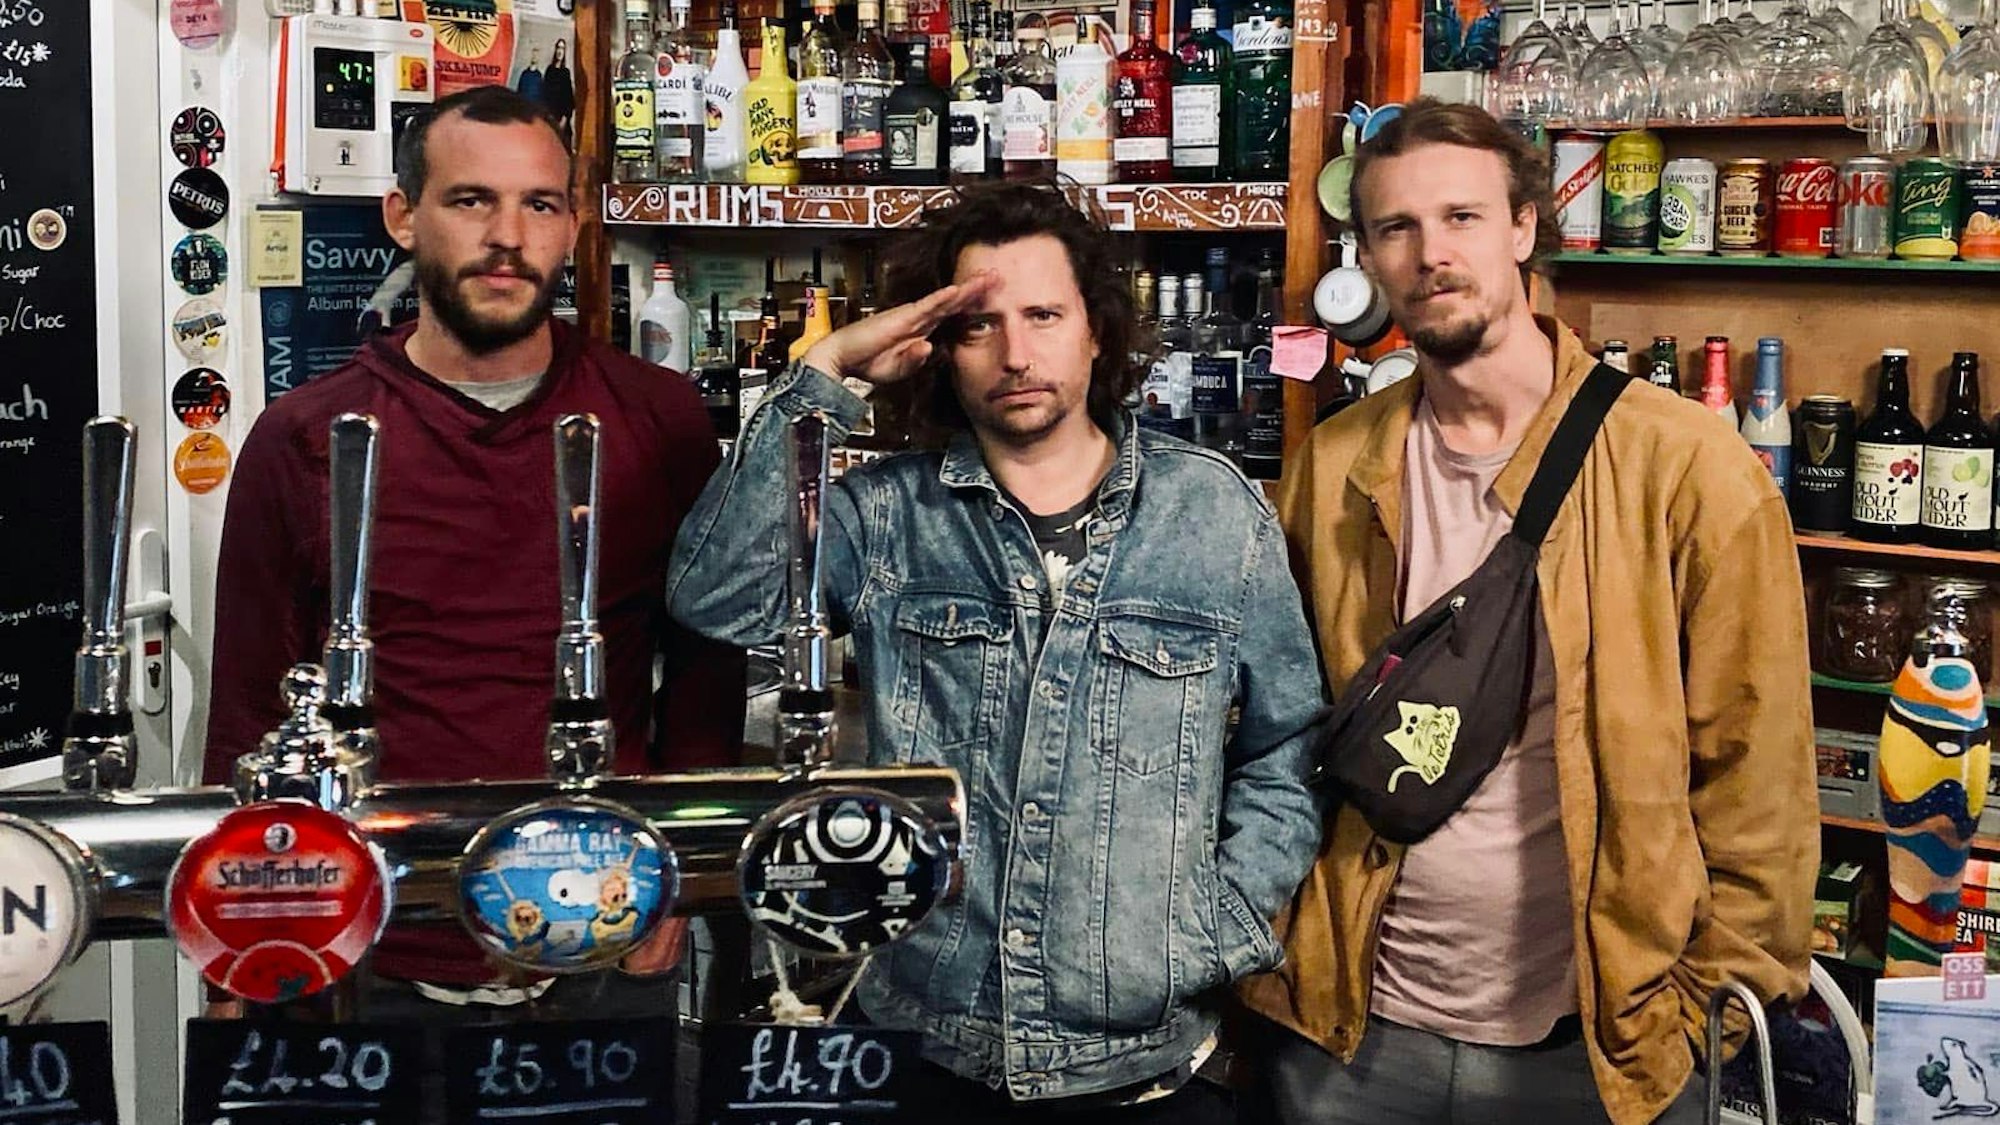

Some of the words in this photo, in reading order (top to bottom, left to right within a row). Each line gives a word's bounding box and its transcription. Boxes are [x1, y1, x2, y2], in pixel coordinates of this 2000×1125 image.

[1234, 29, 1291, 47] Gordon's
[172, 182, 224, 214] PETRUS
[669, 184, 783, 227] RUMS
[306, 239, 396, 275] Savvy
[2, 264, 40, 285] Sugar
[308, 296, 353, 311] Album
[217, 859, 341, 891] Schöfferhofer
[475, 1038, 638, 1096] £5.90
[741, 1028, 893, 1100] £4.90
